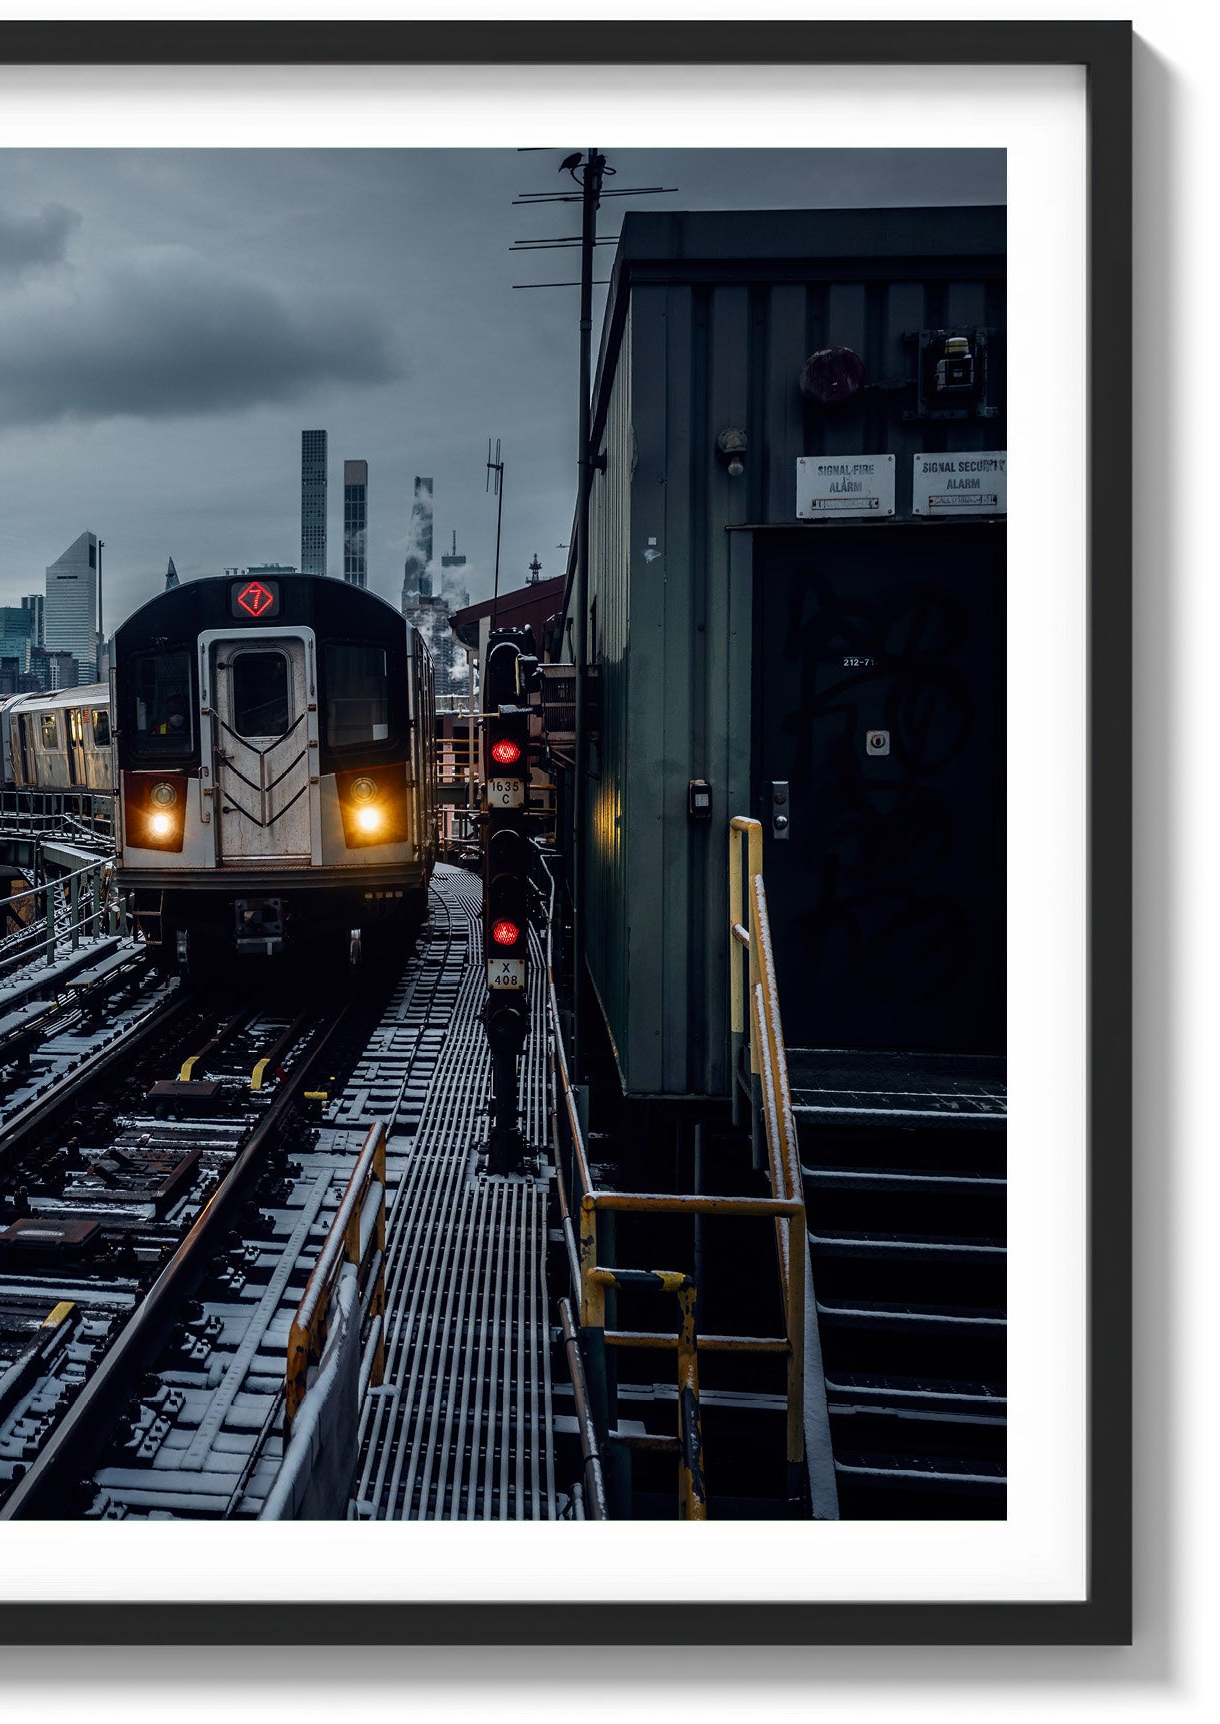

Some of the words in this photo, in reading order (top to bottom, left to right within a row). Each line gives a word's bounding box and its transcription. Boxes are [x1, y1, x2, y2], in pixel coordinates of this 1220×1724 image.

[817, 464, 851, 477] SIGNAL
[853, 464, 875, 475] FIRE
[922, 462, 956, 474] SIGNAL
[829, 481, 863, 493] ALARM
[946, 478, 981, 490] ALARM
[249, 589, 261, 609] 7
[491, 781, 520, 792] 1635
[501, 794, 510, 805] C
[501, 963, 510, 974] X
[494, 976, 518, 986] 408
